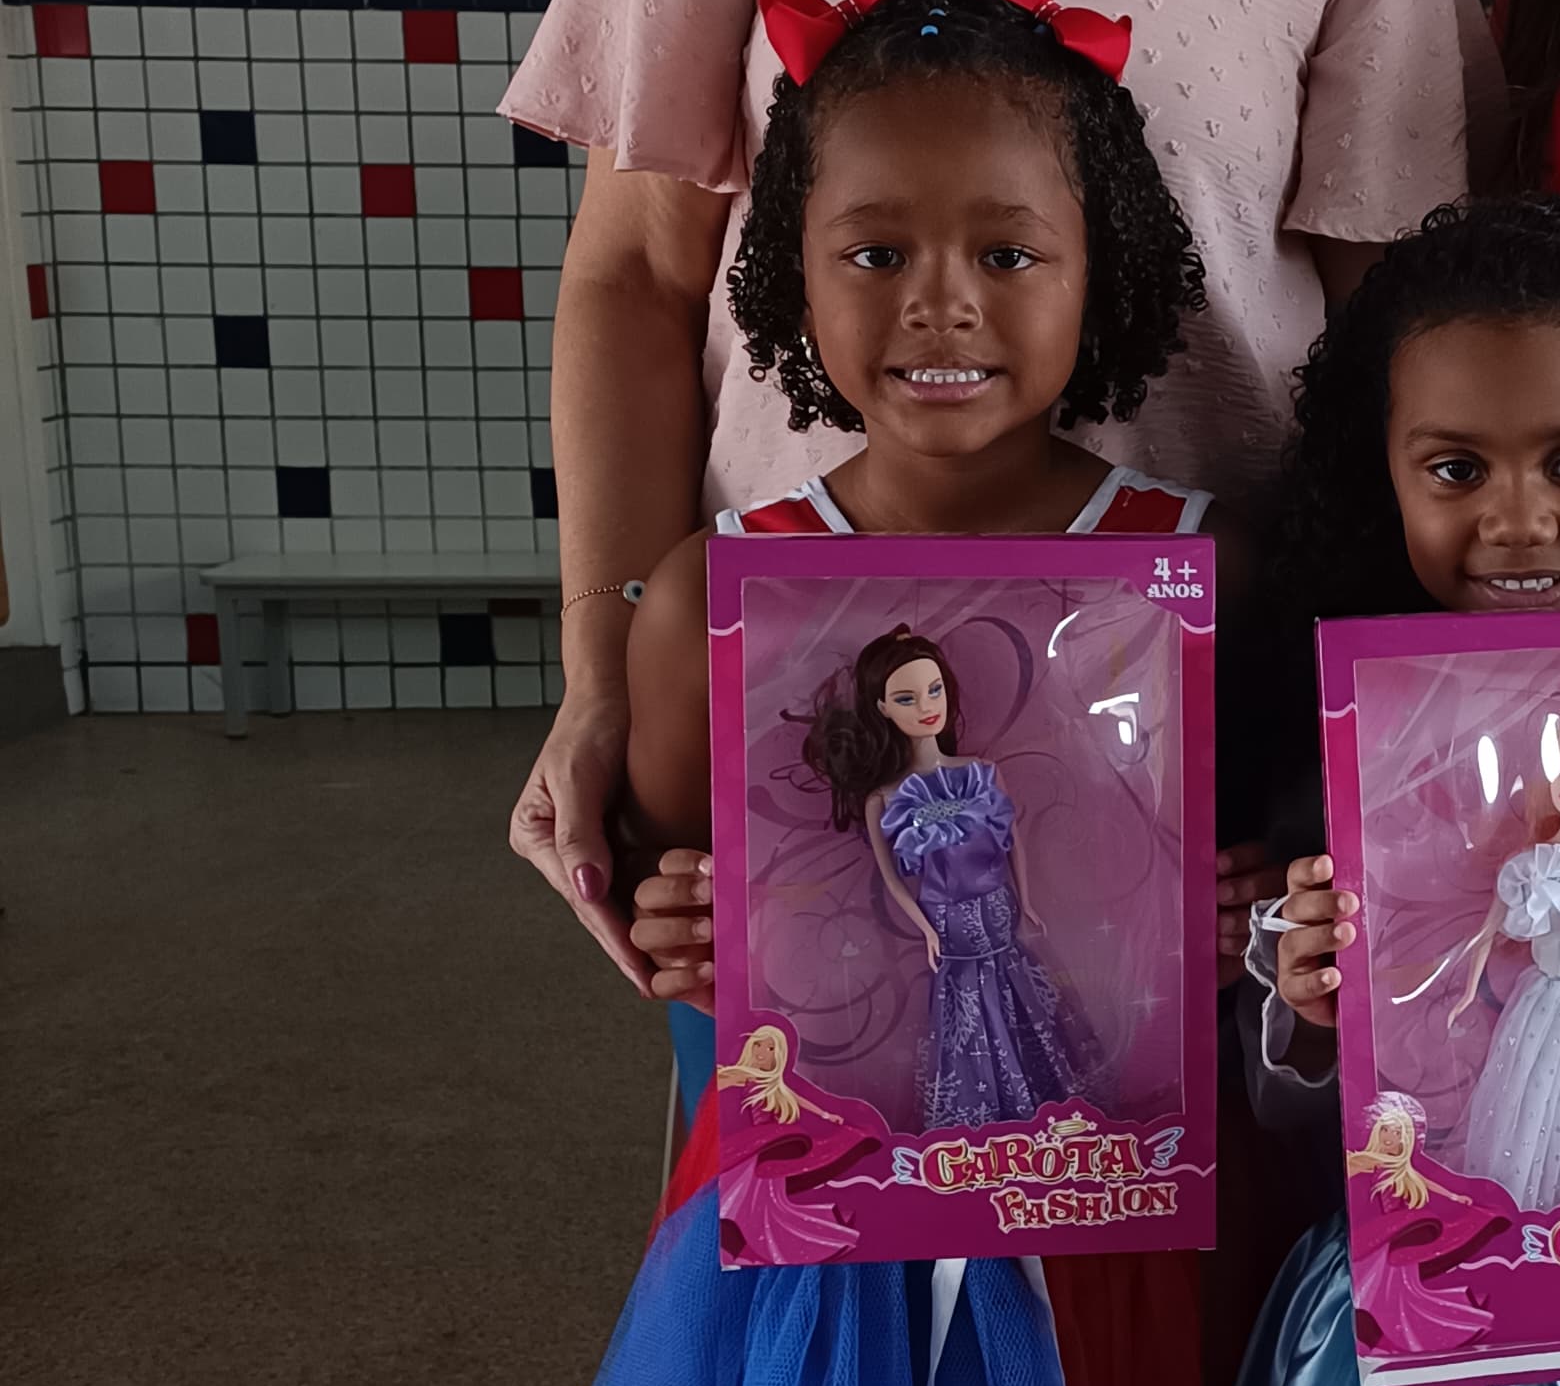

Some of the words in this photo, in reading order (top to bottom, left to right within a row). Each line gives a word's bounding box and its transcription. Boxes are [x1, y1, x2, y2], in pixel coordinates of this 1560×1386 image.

[1153, 557, 1198, 582] 4+
[1146, 583, 1204, 599] ANOS
[920, 1134, 1149, 1194] GAROTA
[990, 1182, 1178, 1234] FASHION
